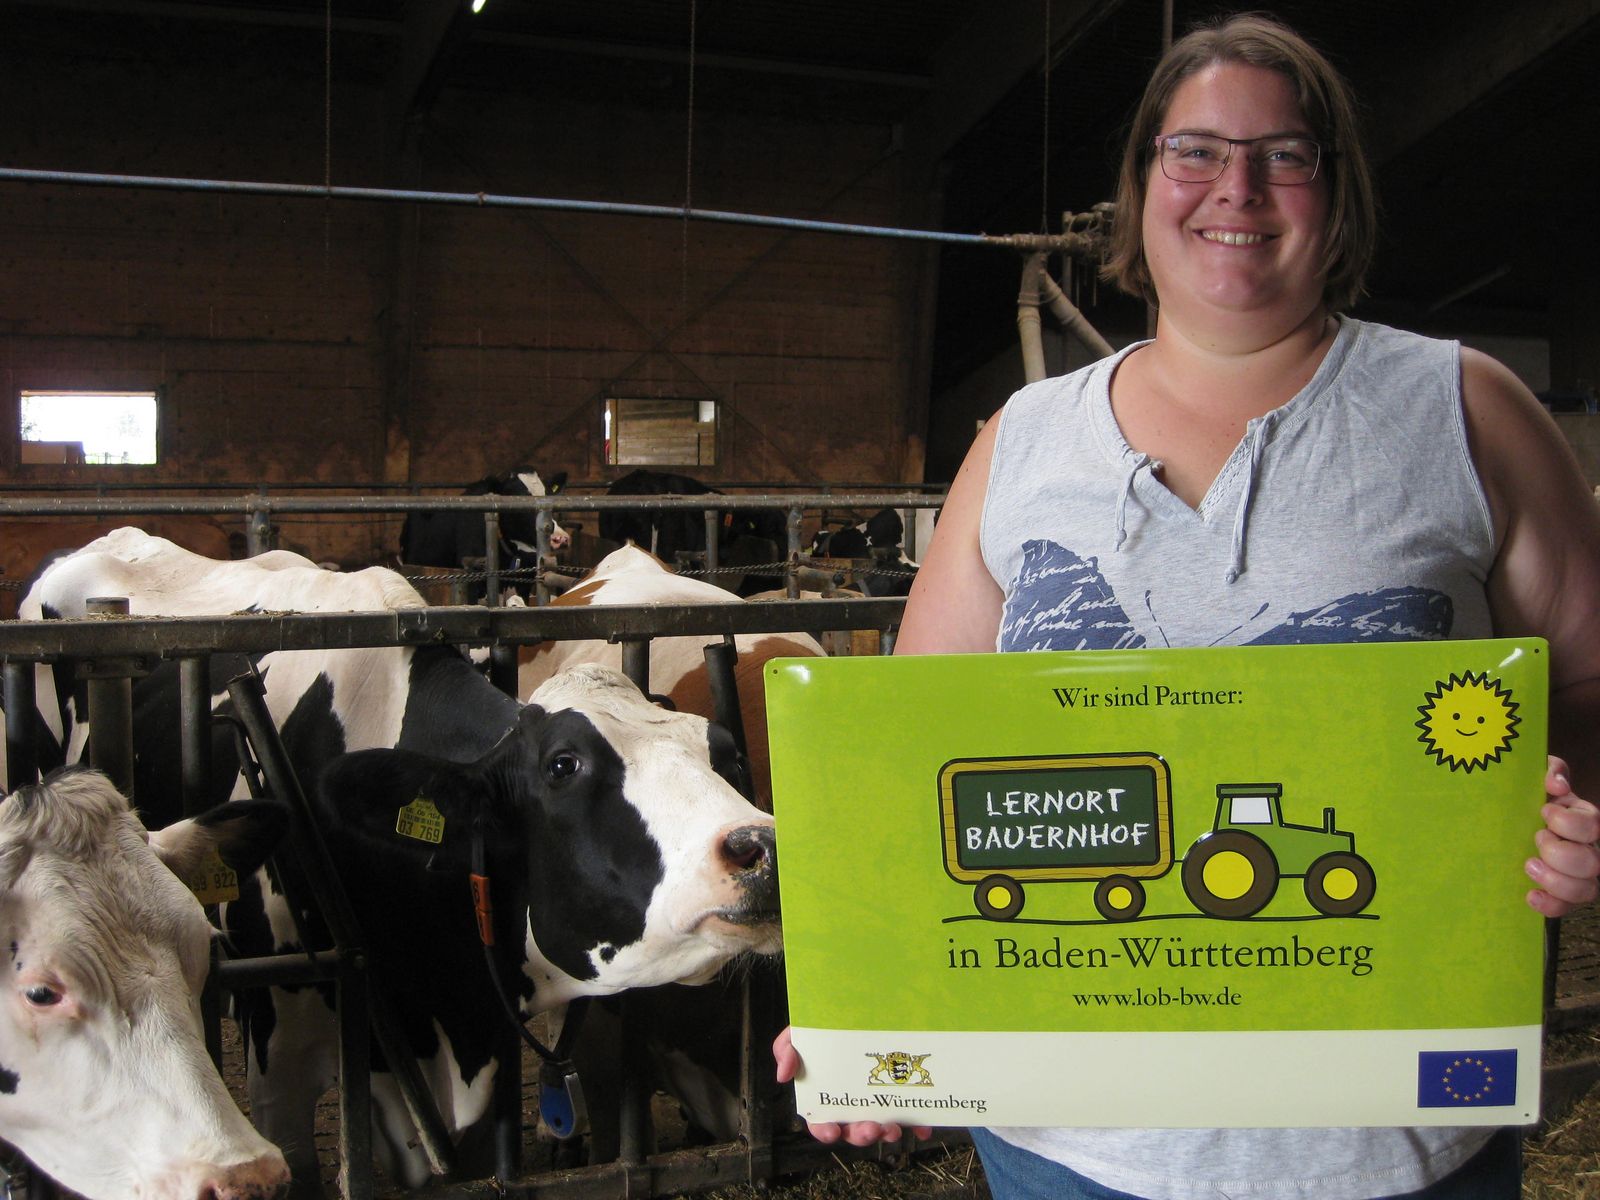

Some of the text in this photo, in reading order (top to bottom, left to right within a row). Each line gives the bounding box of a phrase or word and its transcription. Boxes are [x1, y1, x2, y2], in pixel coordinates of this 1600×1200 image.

[1052, 685, 1243, 708] Wir sind Partner:
[986, 788, 1126, 816] LERNORT
[420, 825, 440, 841] 769
[966, 823, 1150, 850] BAUERNHOF
[948, 935, 1374, 976] in Baden-Württemberg
[1073, 986, 1242, 1006] www.lob-bw.de
[819, 1092, 987, 1113] Baden-Württemberg
